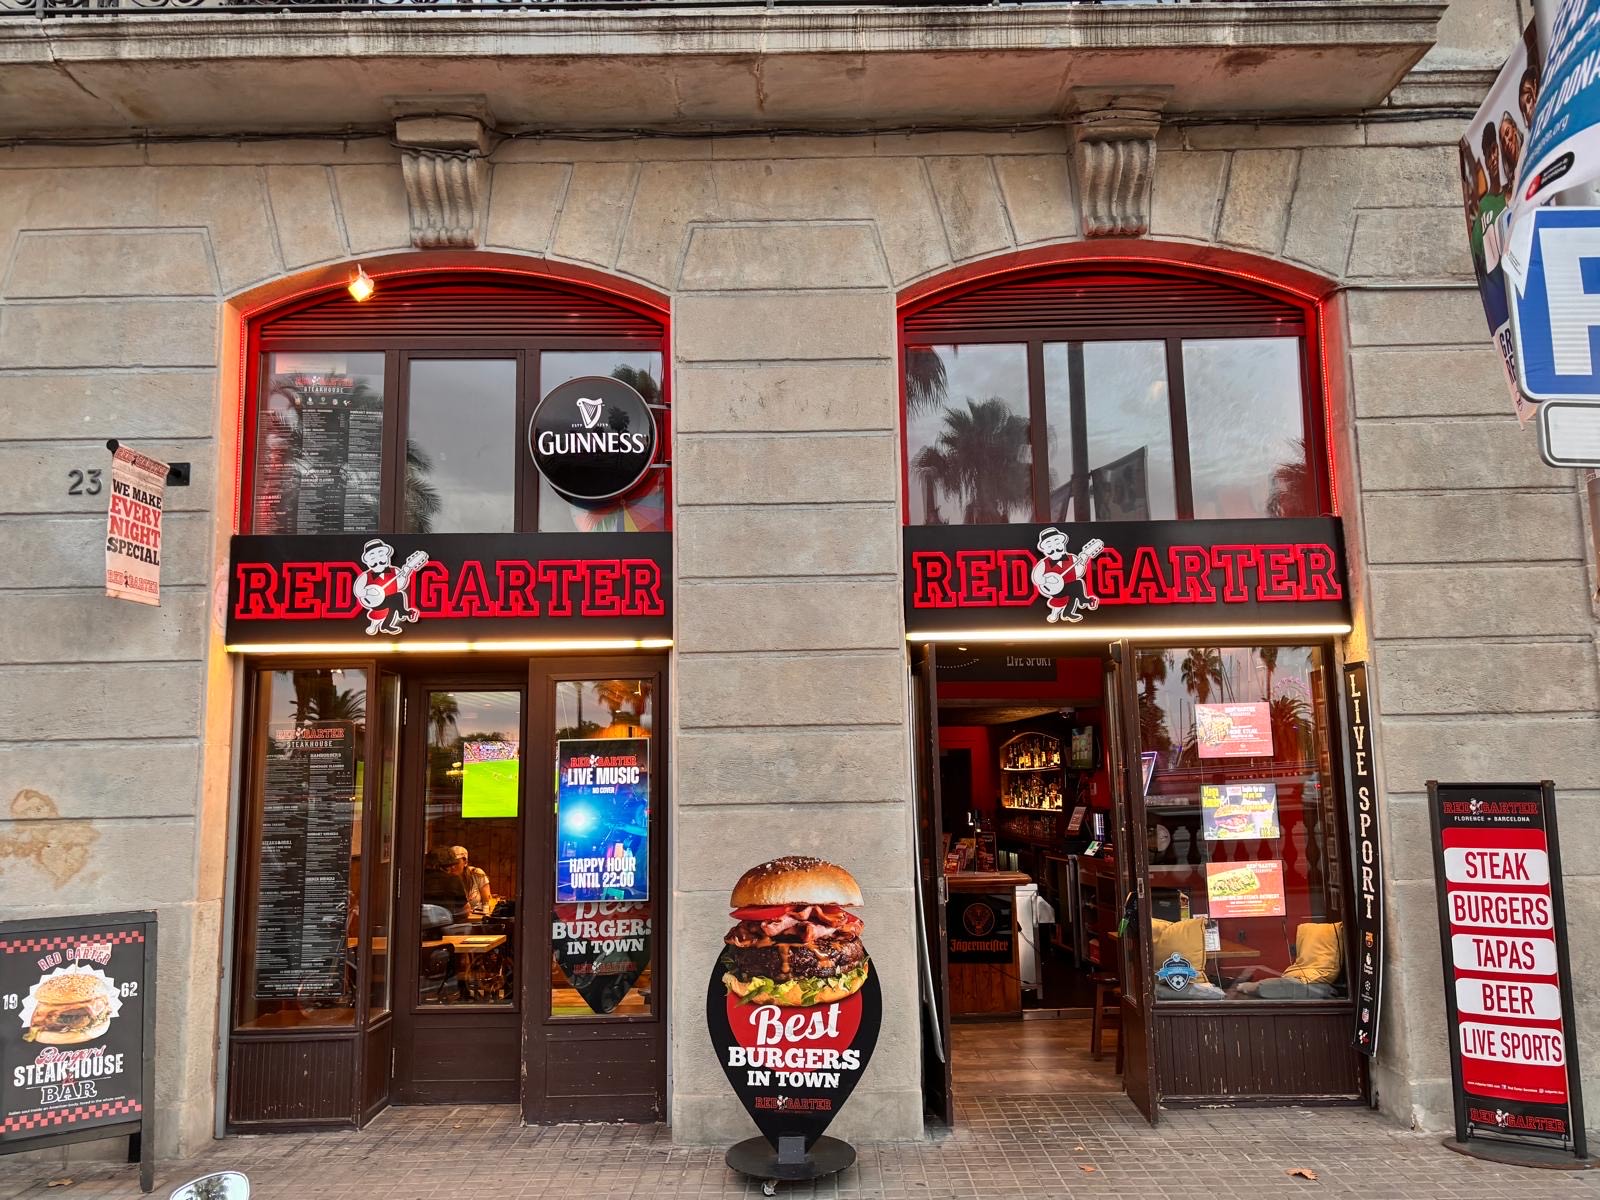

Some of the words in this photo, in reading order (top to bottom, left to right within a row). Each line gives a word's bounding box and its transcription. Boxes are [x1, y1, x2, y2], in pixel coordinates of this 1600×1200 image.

[538, 431, 645, 455] GUINNESS
[68, 468, 103, 495] 23
[113, 479, 130, 497] WE
[132, 486, 162, 510] MAKE
[110, 494, 161, 528] EVERY
[109, 515, 161, 549] NIGHT
[106, 537, 160, 566] SPECIAL
[235, 562, 360, 619] RED
[411, 559, 665, 619] GARTER
[912, 550, 1038, 608] RED
[1091, 543, 1342, 606] GARTER
[1350, 674, 1368, 776] LIVE
[567, 767, 594, 786] LIVE
[596, 766, 640, 785] MUSIC
[600, 786, 615, 794] COVER
[1443, 801, 1470, 814] RED
[1481, 802, 1538, 814] GARTER
[569, 857, 605, 873] HAPPY
[606, 857, 636, 872] HOUR
[1358, 786, 1375, 919] SPORT
[1464, 851, 1530, 881] STEAK
[571, 872, 601, 889] UNTIL
[602, 871, 634, 888] 22:00
[1453, 894, 1549, 926] BURGERS
[38, 951, 62, 972] RED
[66, 945, 111, 966] GARTER
[567, 941, 588, 955] IN
[591, 938, 644, 955] TOWN
[1472, 938, 1535, 970] TAPAS
[2, 994, 18, 1010] 19
[121, 982, 138, 998] 62
[1481, 983, 1535, 1015] BEER
[749, 1002, 842, 1046] Best
[35, 1045, 106, 1067] Burgers
[728, 1046, 861, 1071] BURGERS
[1462, 1027, 1497, 1057] LIVE
[1500, 1032, 1562, 1063] SPORTS
[41, 1079, 98, 1104] BAR
[747, 1071, 771, 1087] IN
[775, 1071, 841, 1088] TOWN
[755, 1096, 777, 1110] RED
[787, 1097, 832, 1111] GARTER
[1469, 1107, 1496, 1124] RED
[1506, 1114, 1566, 1133] GARTER
